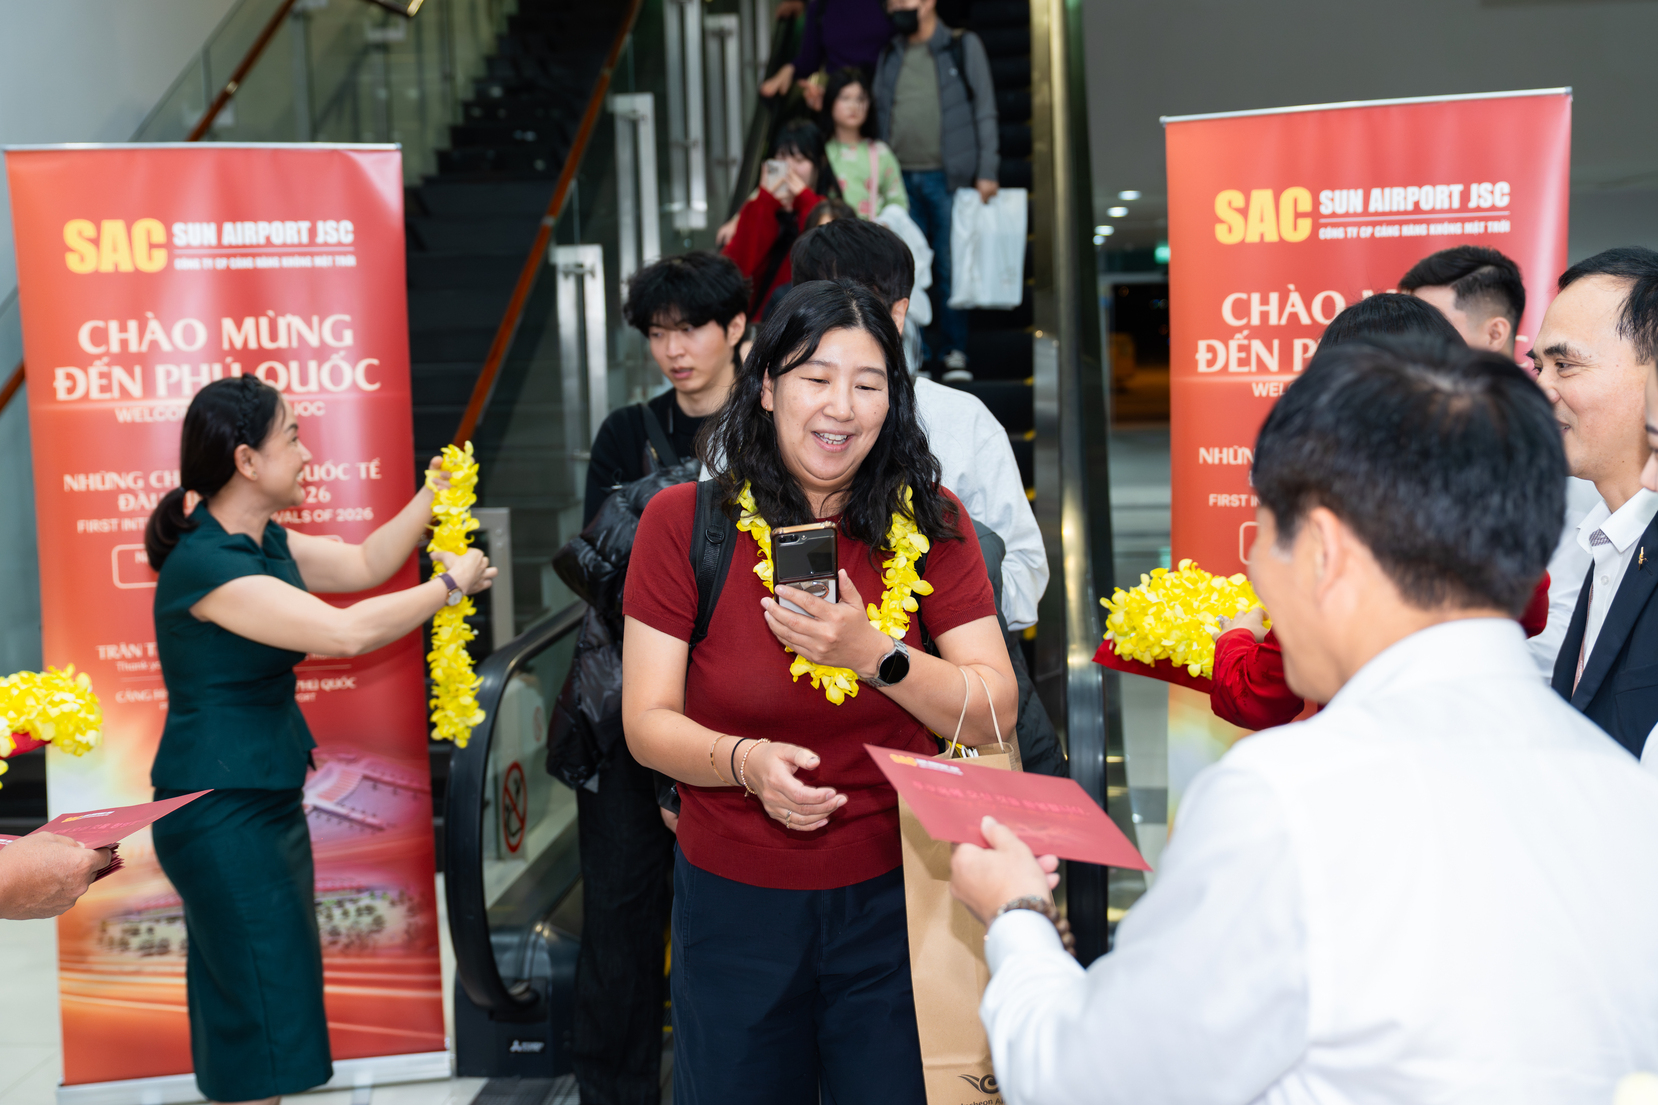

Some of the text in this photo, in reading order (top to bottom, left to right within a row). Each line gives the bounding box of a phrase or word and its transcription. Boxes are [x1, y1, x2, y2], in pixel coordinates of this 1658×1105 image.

[1214, 186, 1313, 244] SAC
[1319, 181, 1511, 215] SUN AIRPORT JSC
[63, 218, 168, 274] SAC
[172, 219, 355, 247] SUN AIRPORT JSC
[1318, 225, 1346, 240] CÔNG
[1346, 226, 1359, 239] TY
[1359, 226, 1373, 239] CP
[1222, 284, 1346, 327] CHÀO
[78, 309, 354, 355] CHÀO MỪNG
[1195, 330, 1279, 373] ĐẾN
[53, 356, 143, 401] ĐẾN
[255, 350, 381, 396] QUỐC
[114, 405, 189, 424] WELCO
[1199, 445, 1257, 466] NHỮN
[63, 470, 145, 492] NHỮNG
[355, 456, 382, 480] TẾ
[302, 485, 332, 504] 26
[1209, 493, 1248, 508] FIRST
[77, 518, 119, 534] FIRST
[313, 508, 334, 523] OF
[335, 506, 374, 522] 2026
